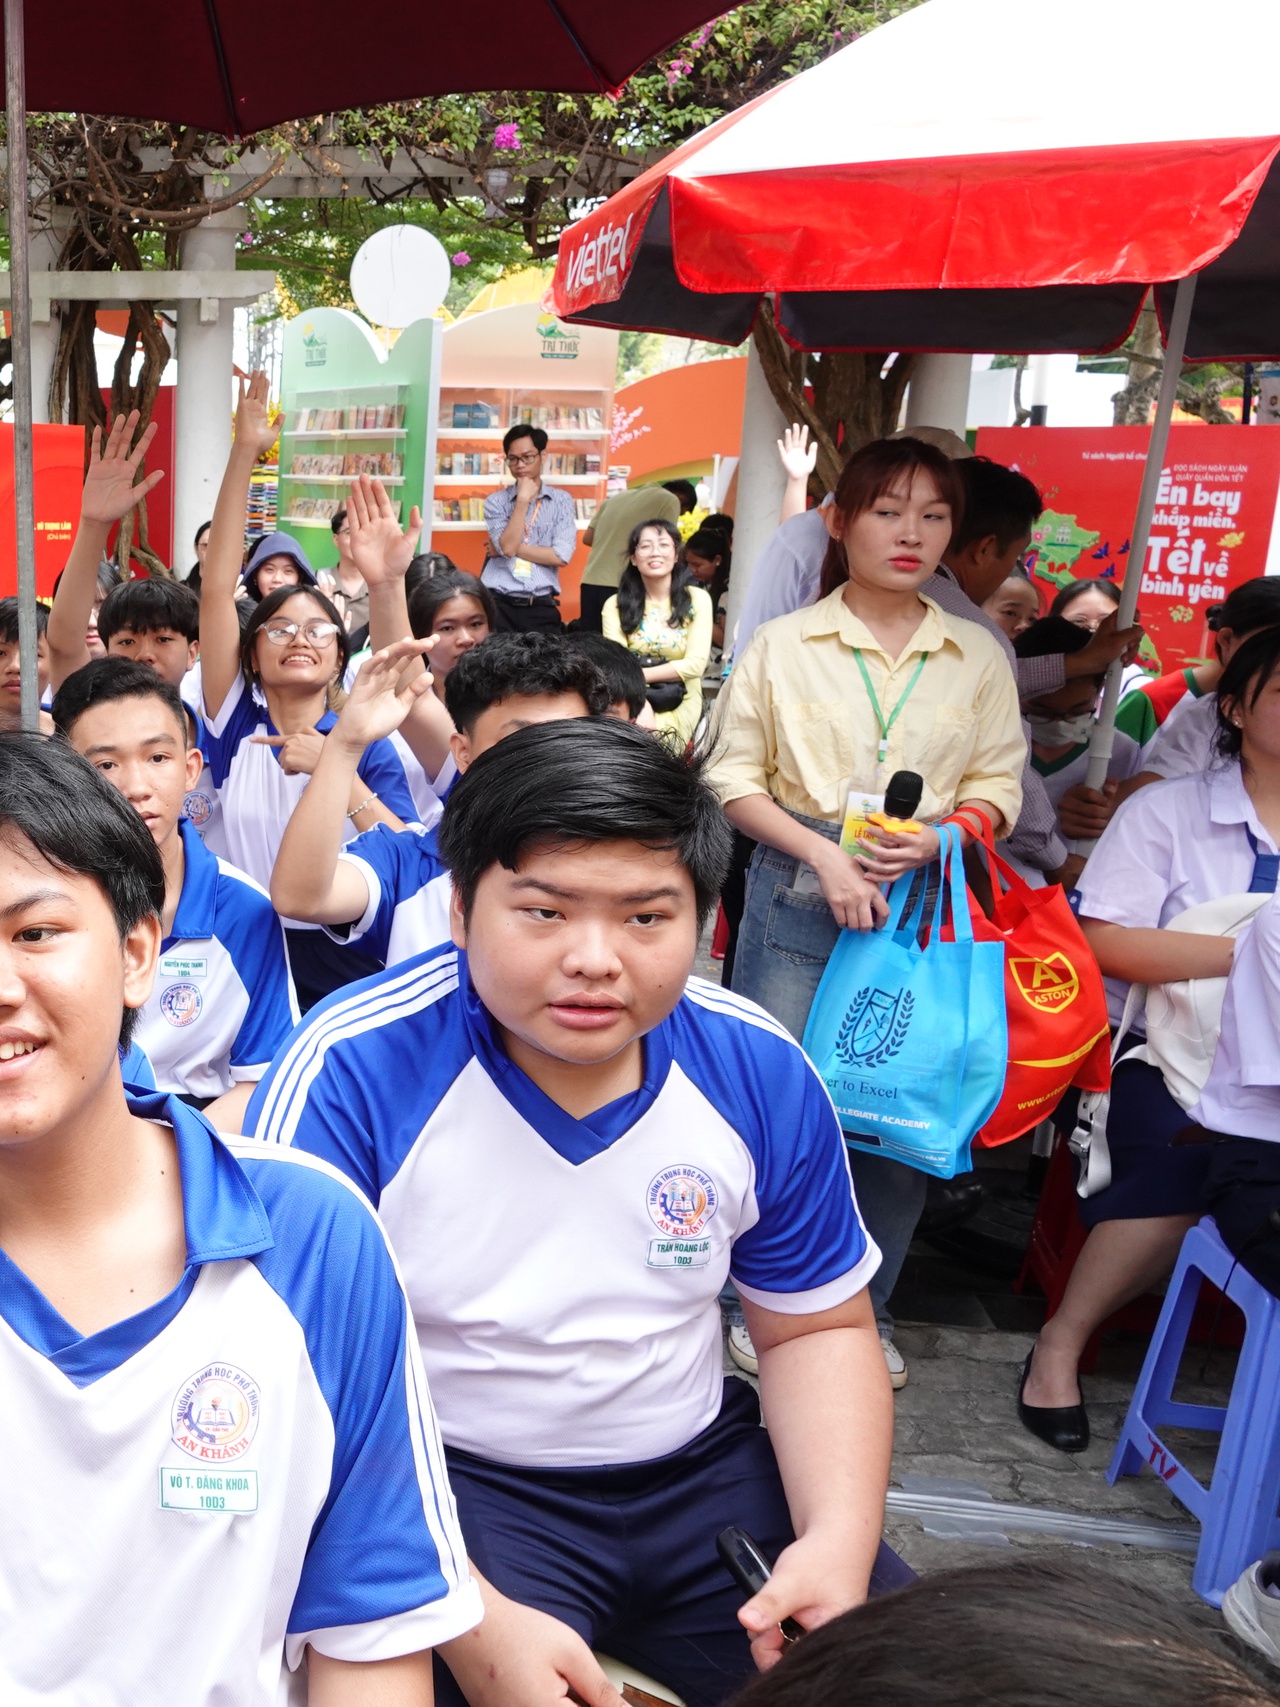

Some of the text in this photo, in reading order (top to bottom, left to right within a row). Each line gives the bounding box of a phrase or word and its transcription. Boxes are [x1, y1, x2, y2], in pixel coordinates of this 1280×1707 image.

[1155, 468, 1242, 515] Én bay
[1147, 528, 1229, 578] Tết về
[1140, 573, 1225, 604] bình yên
[1032, 962, 1063, 989] A
[1034, 989, 1071, 1005] ASTON
[842, 1080, 855, 1092] to
[859, 1081, 898, 1099] Excel
[1017, 1077, 1073, 1110] www.aston.
[833, 1105, 931, 1130] OLLEGIATE ACADEMY
[660, 1168, 681, 1182] TRUNG
[682, 1168, 696, 1178] HỌC
[657, 1218, 704, 1236] AN KHÁNH
[673, 1256, 692, 1265] 10D3
[177, 1435, 249, 1460] AN KHÁNH
[185, 1476, 194, 1489] T.
[225, 1478, 250, 1491] KHOA
[199, 1495, 226, 1509] 10D3
